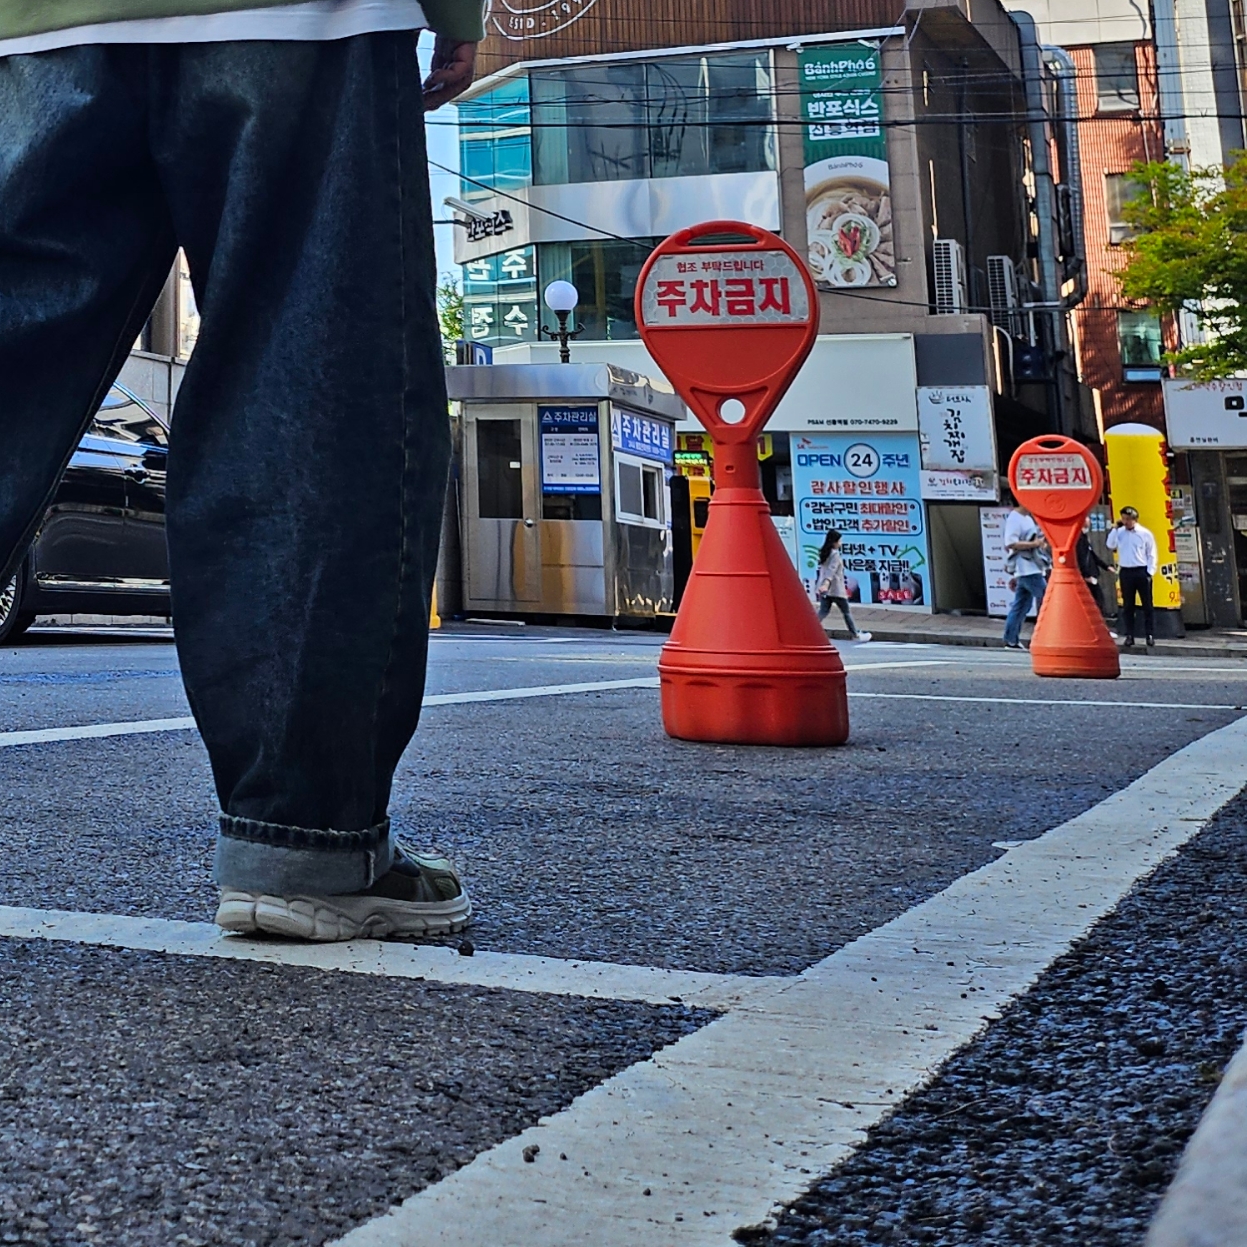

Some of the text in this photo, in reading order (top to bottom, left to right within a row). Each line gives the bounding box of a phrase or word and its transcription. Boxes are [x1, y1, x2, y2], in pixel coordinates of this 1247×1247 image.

[807, 98, 879, 118] 반포식스
[676, 260, 764, 273] 협조 부탁드립니다
[656, 277, 791, 318] 주차금지
[554, 411, 597, 423] 주차관리실
[622, 414, 670, 449] 주차관리실
[797, 453, 910, 468] OPEN 24 주년
[1021, 467, 1087, 485] 주차금지
[811, 501, 908, 516] 강남구민 최대할인
[812, 518, 910, 533] 법인고객 추가할인
[838, 543, 866, 556] 터넷
[877, 544, 899, 556] TV
[878, 590, 910, 601] SALE
